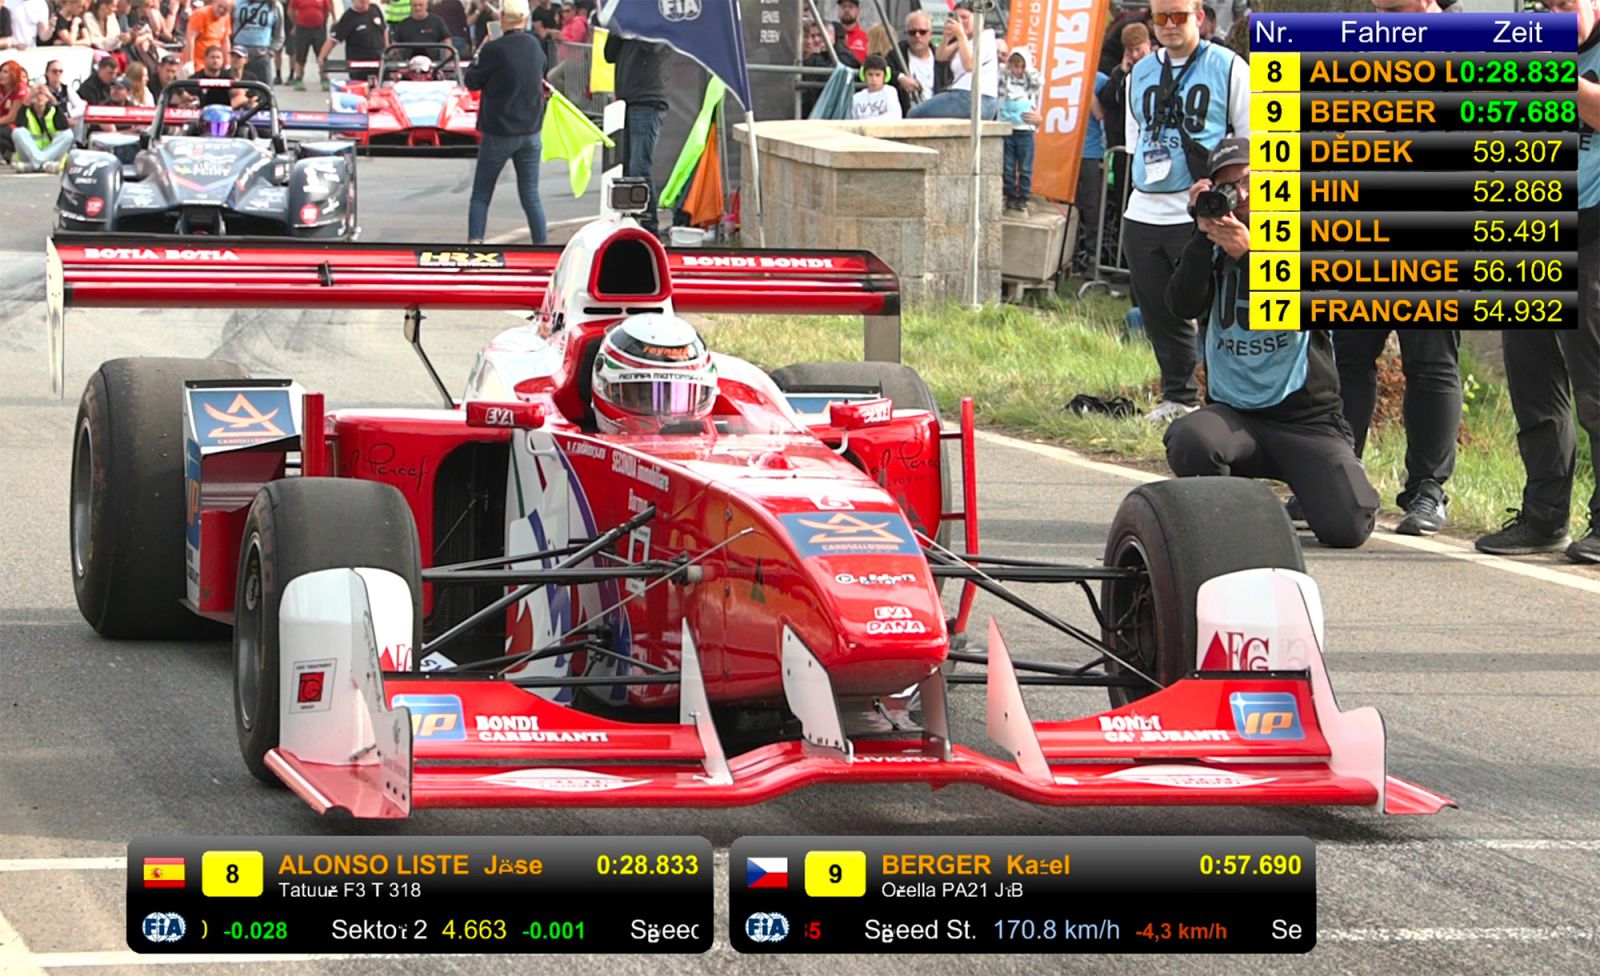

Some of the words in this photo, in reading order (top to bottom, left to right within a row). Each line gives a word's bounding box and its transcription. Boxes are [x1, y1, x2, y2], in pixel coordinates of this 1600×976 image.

[239, 7, 269, 27] 020
[1143, 84, 1211, 133] 09
[84, 248, 159, 259] BOTIA
[165, 249, 240, 261] BOTIA
[682, 256, 757, 267] BONDI
[760, 257, 833, 268] BONDI
[867, 619, 926, 634] DANA
[475, 715, 539, 731] BONDI
[1244, 711, 1294, 736] IP
[479, 731, 609, 742] CARBURANTI
